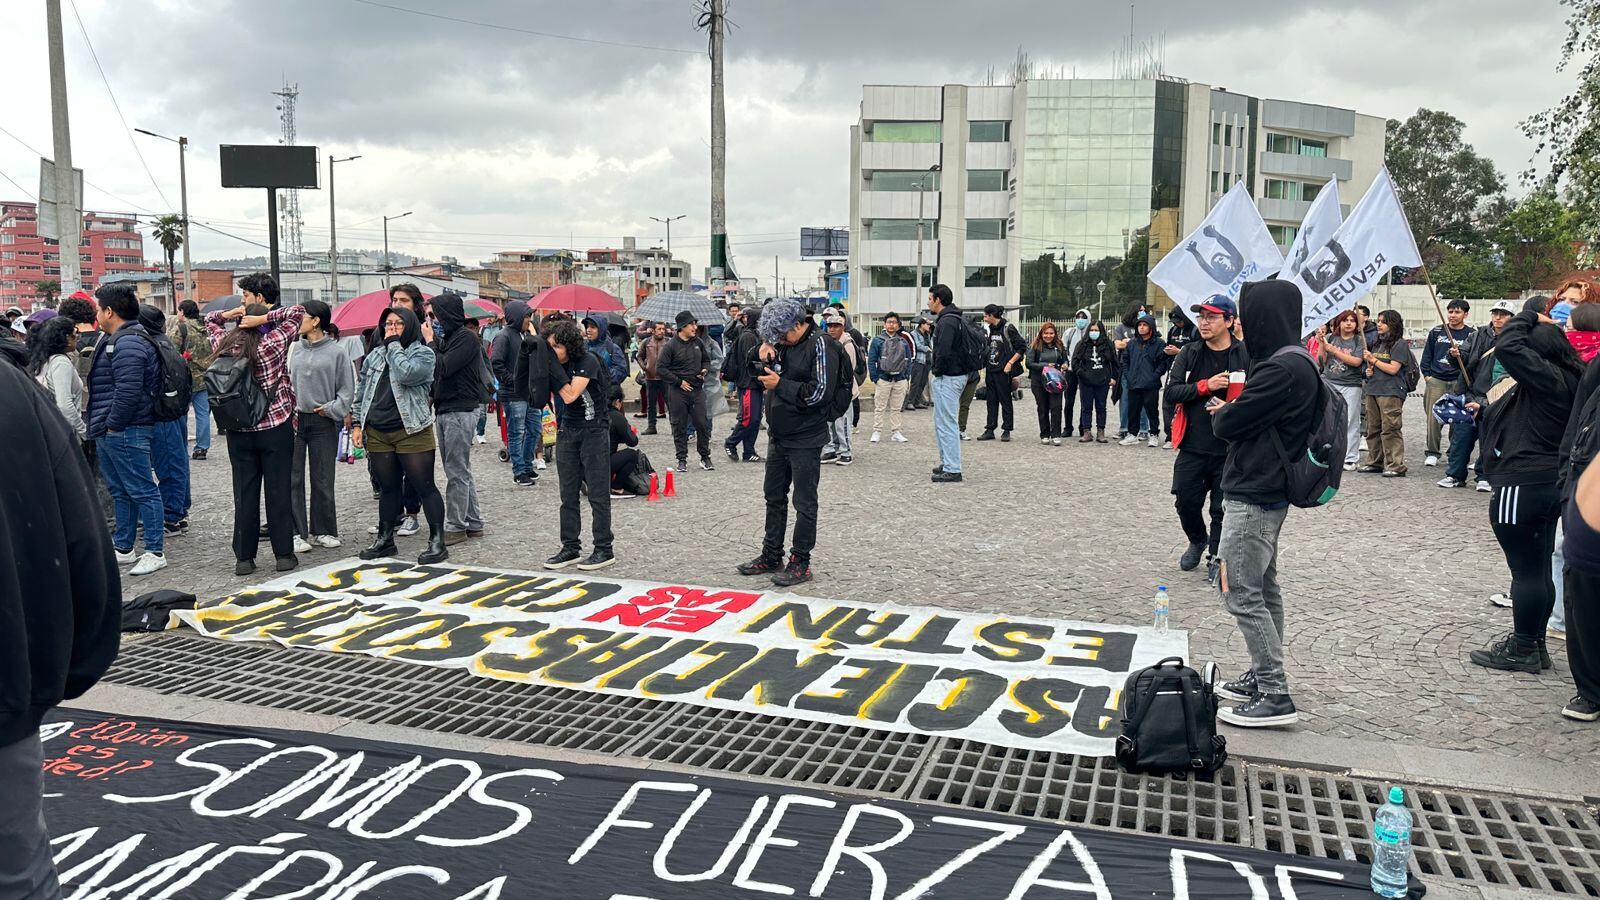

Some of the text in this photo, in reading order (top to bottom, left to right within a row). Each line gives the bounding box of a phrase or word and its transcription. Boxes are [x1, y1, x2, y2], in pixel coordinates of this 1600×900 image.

[297, 562, 622, 612] CALLES
[627, 585, 766, 614] LAS
[585, 605, 728, 633] EN
[478, 627, 1004, 732] CIENCIAS
[1000, 676, 1122, 738] AS
[66, 744, 119, 759] es
[102, 737, 565, 848] SOMOS
[568, 781, 1113, 900] FUERZA
